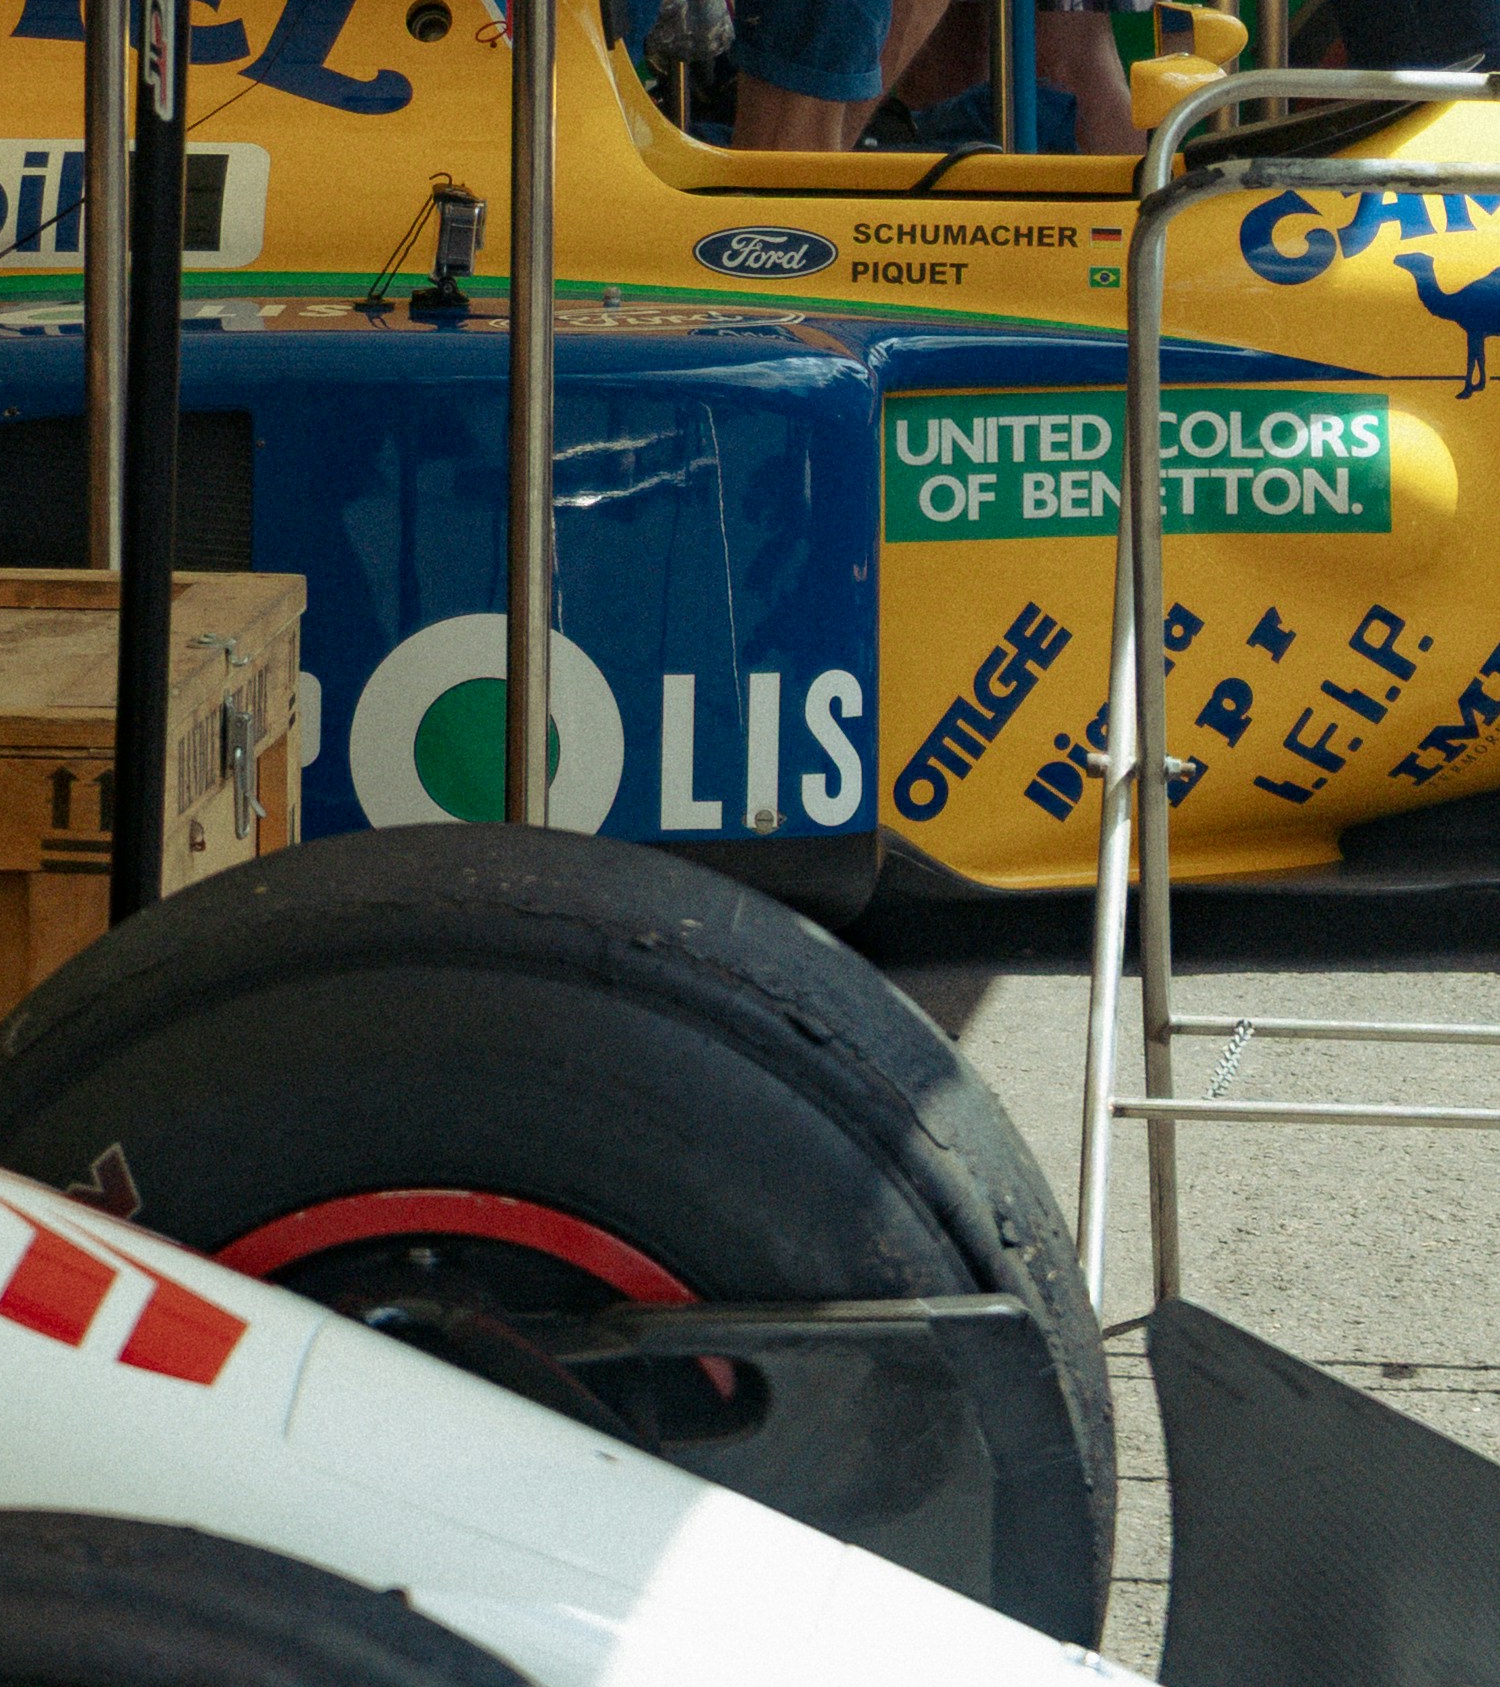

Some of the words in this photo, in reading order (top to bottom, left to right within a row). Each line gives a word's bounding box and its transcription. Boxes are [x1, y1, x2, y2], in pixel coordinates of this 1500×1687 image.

[721, 235, 807, 275] Ford
[852, 222, 1079, 249] SCHUMACHER
[851, 261, 969, 286] PIQUET
[895, 413, 1113, 467] UNITED
[918, 474, 998, 523] OF
[300, 613, 863, 833] OLIS
